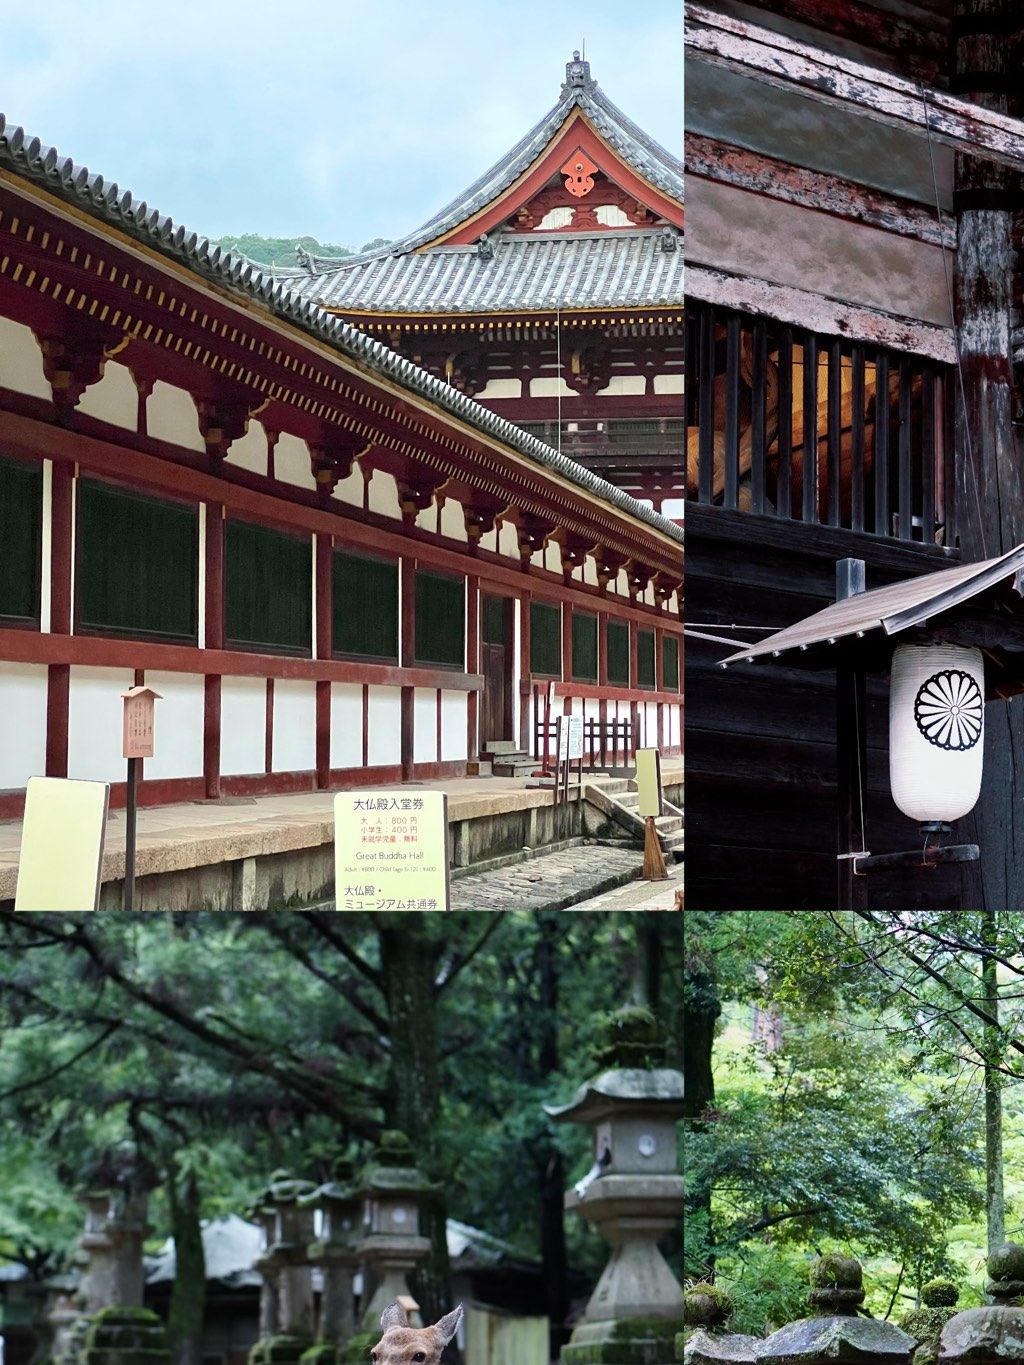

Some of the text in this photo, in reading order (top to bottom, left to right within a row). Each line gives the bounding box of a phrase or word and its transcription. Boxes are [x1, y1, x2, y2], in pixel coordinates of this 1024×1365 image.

[353, 798, 424, 810] 大仏殿入堂券
[356, 852, 424, 860] Great Buddha Hall
[345, 899, 437, 910] ミュージアム共通券
